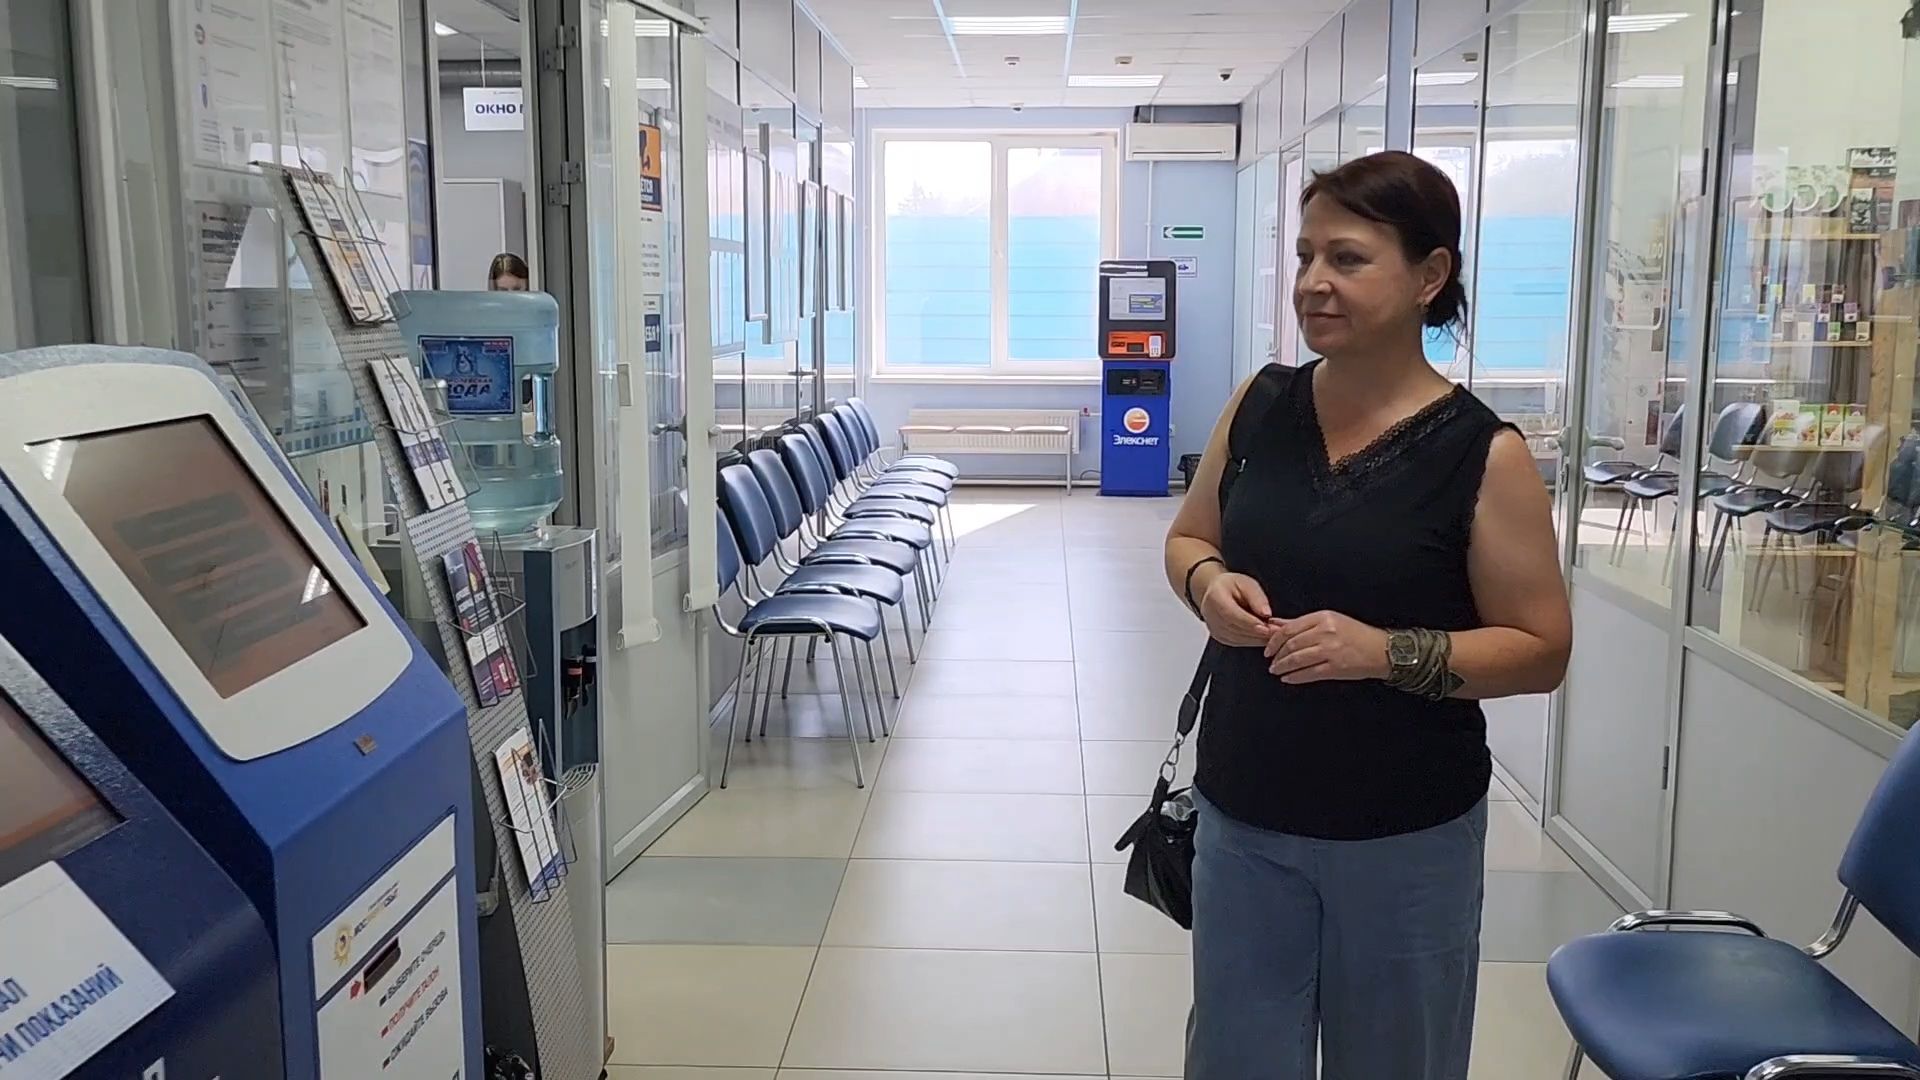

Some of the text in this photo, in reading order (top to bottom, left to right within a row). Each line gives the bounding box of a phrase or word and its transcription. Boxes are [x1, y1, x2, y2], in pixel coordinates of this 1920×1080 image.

[475, 104, 516, 114] ОКНО
[1112, 434, 1160, 446] Элекснет
[14, 963, 124, 1047] ПОКАЗАНИЙ
